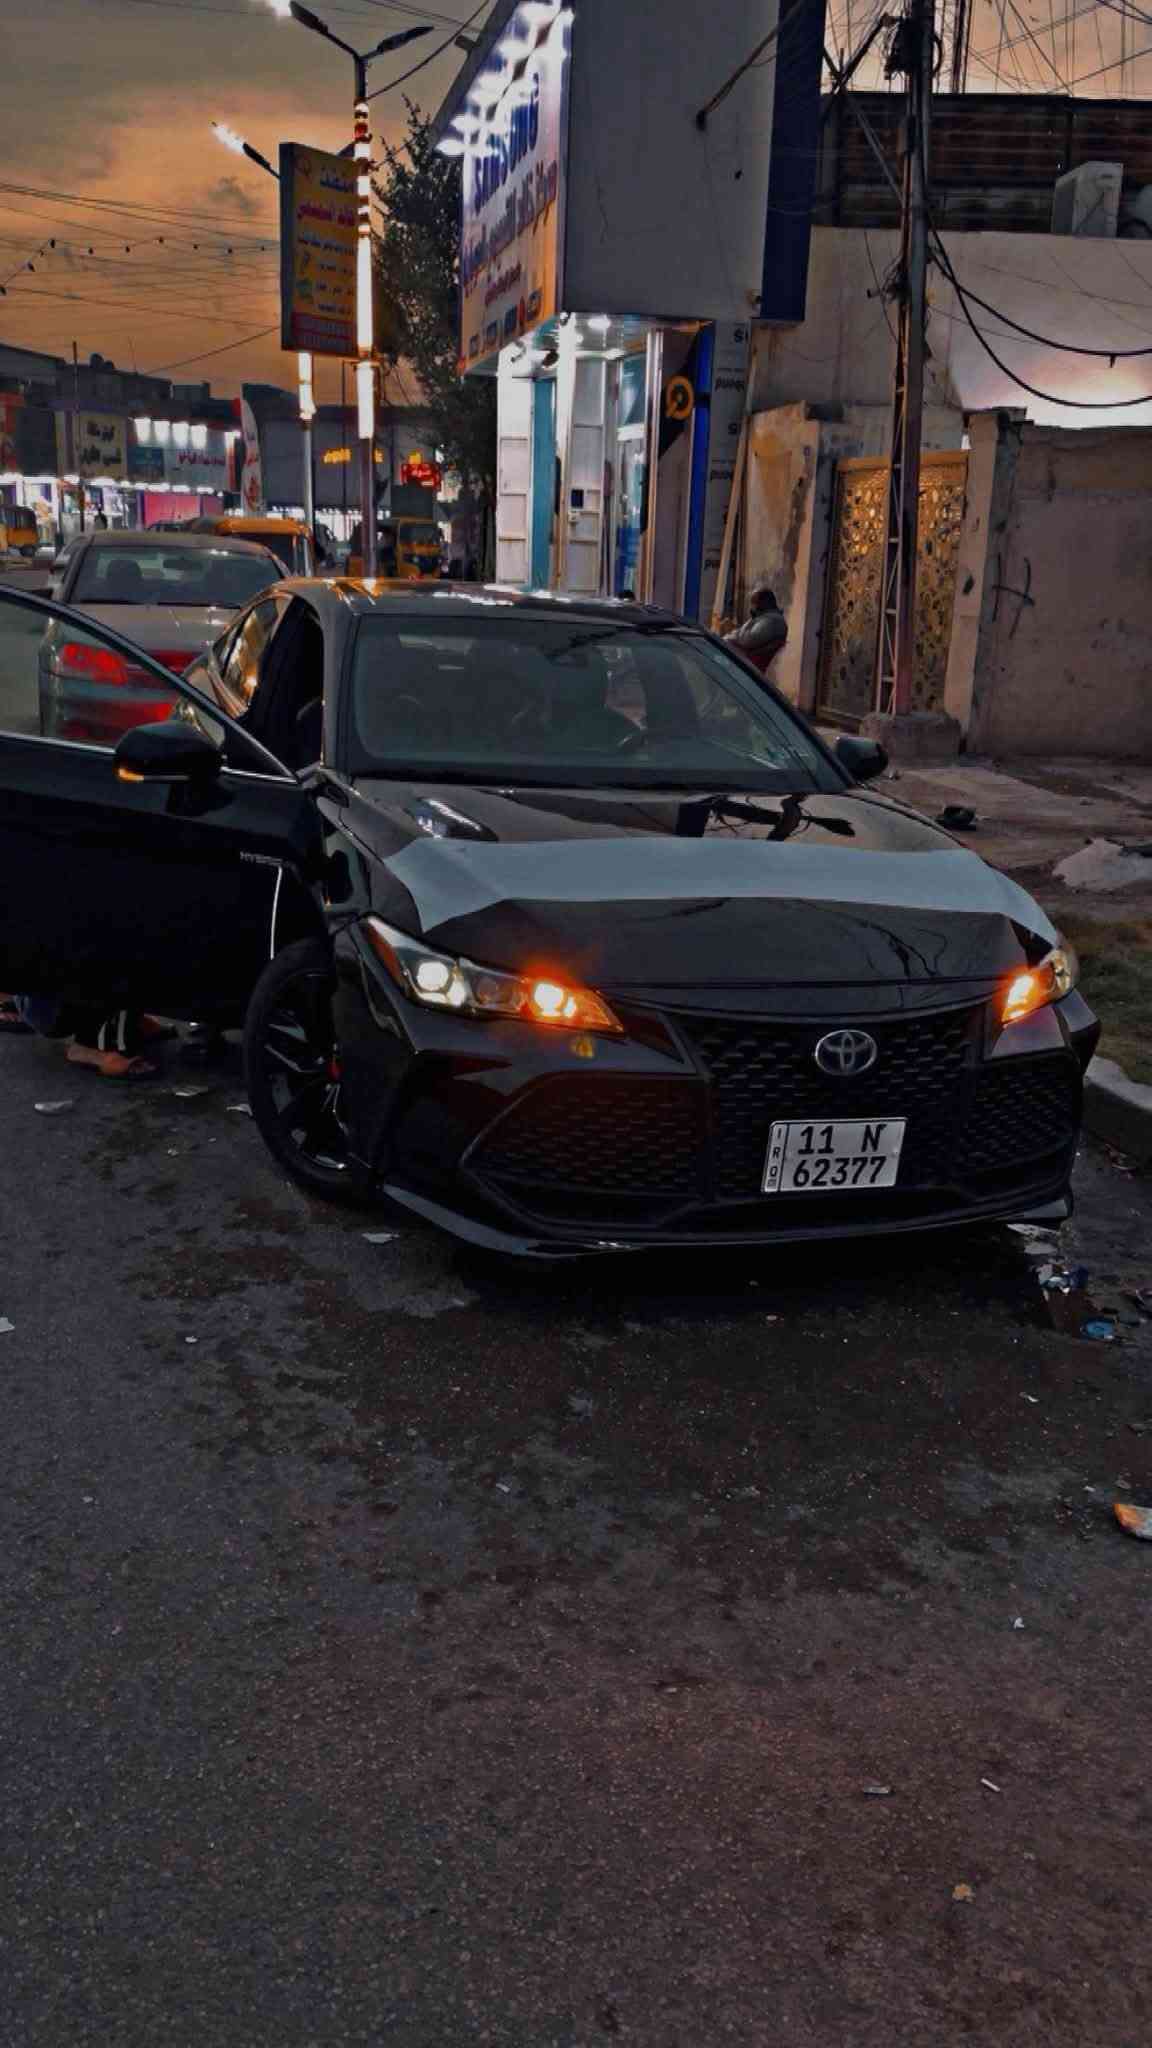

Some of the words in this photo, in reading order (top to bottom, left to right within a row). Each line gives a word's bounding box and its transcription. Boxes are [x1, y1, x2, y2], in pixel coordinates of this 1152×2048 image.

[797, 1125, 835, 1155] 11
[861, 1124, 885, 1153] N
[793, 1156, 887, 1187] 62377
